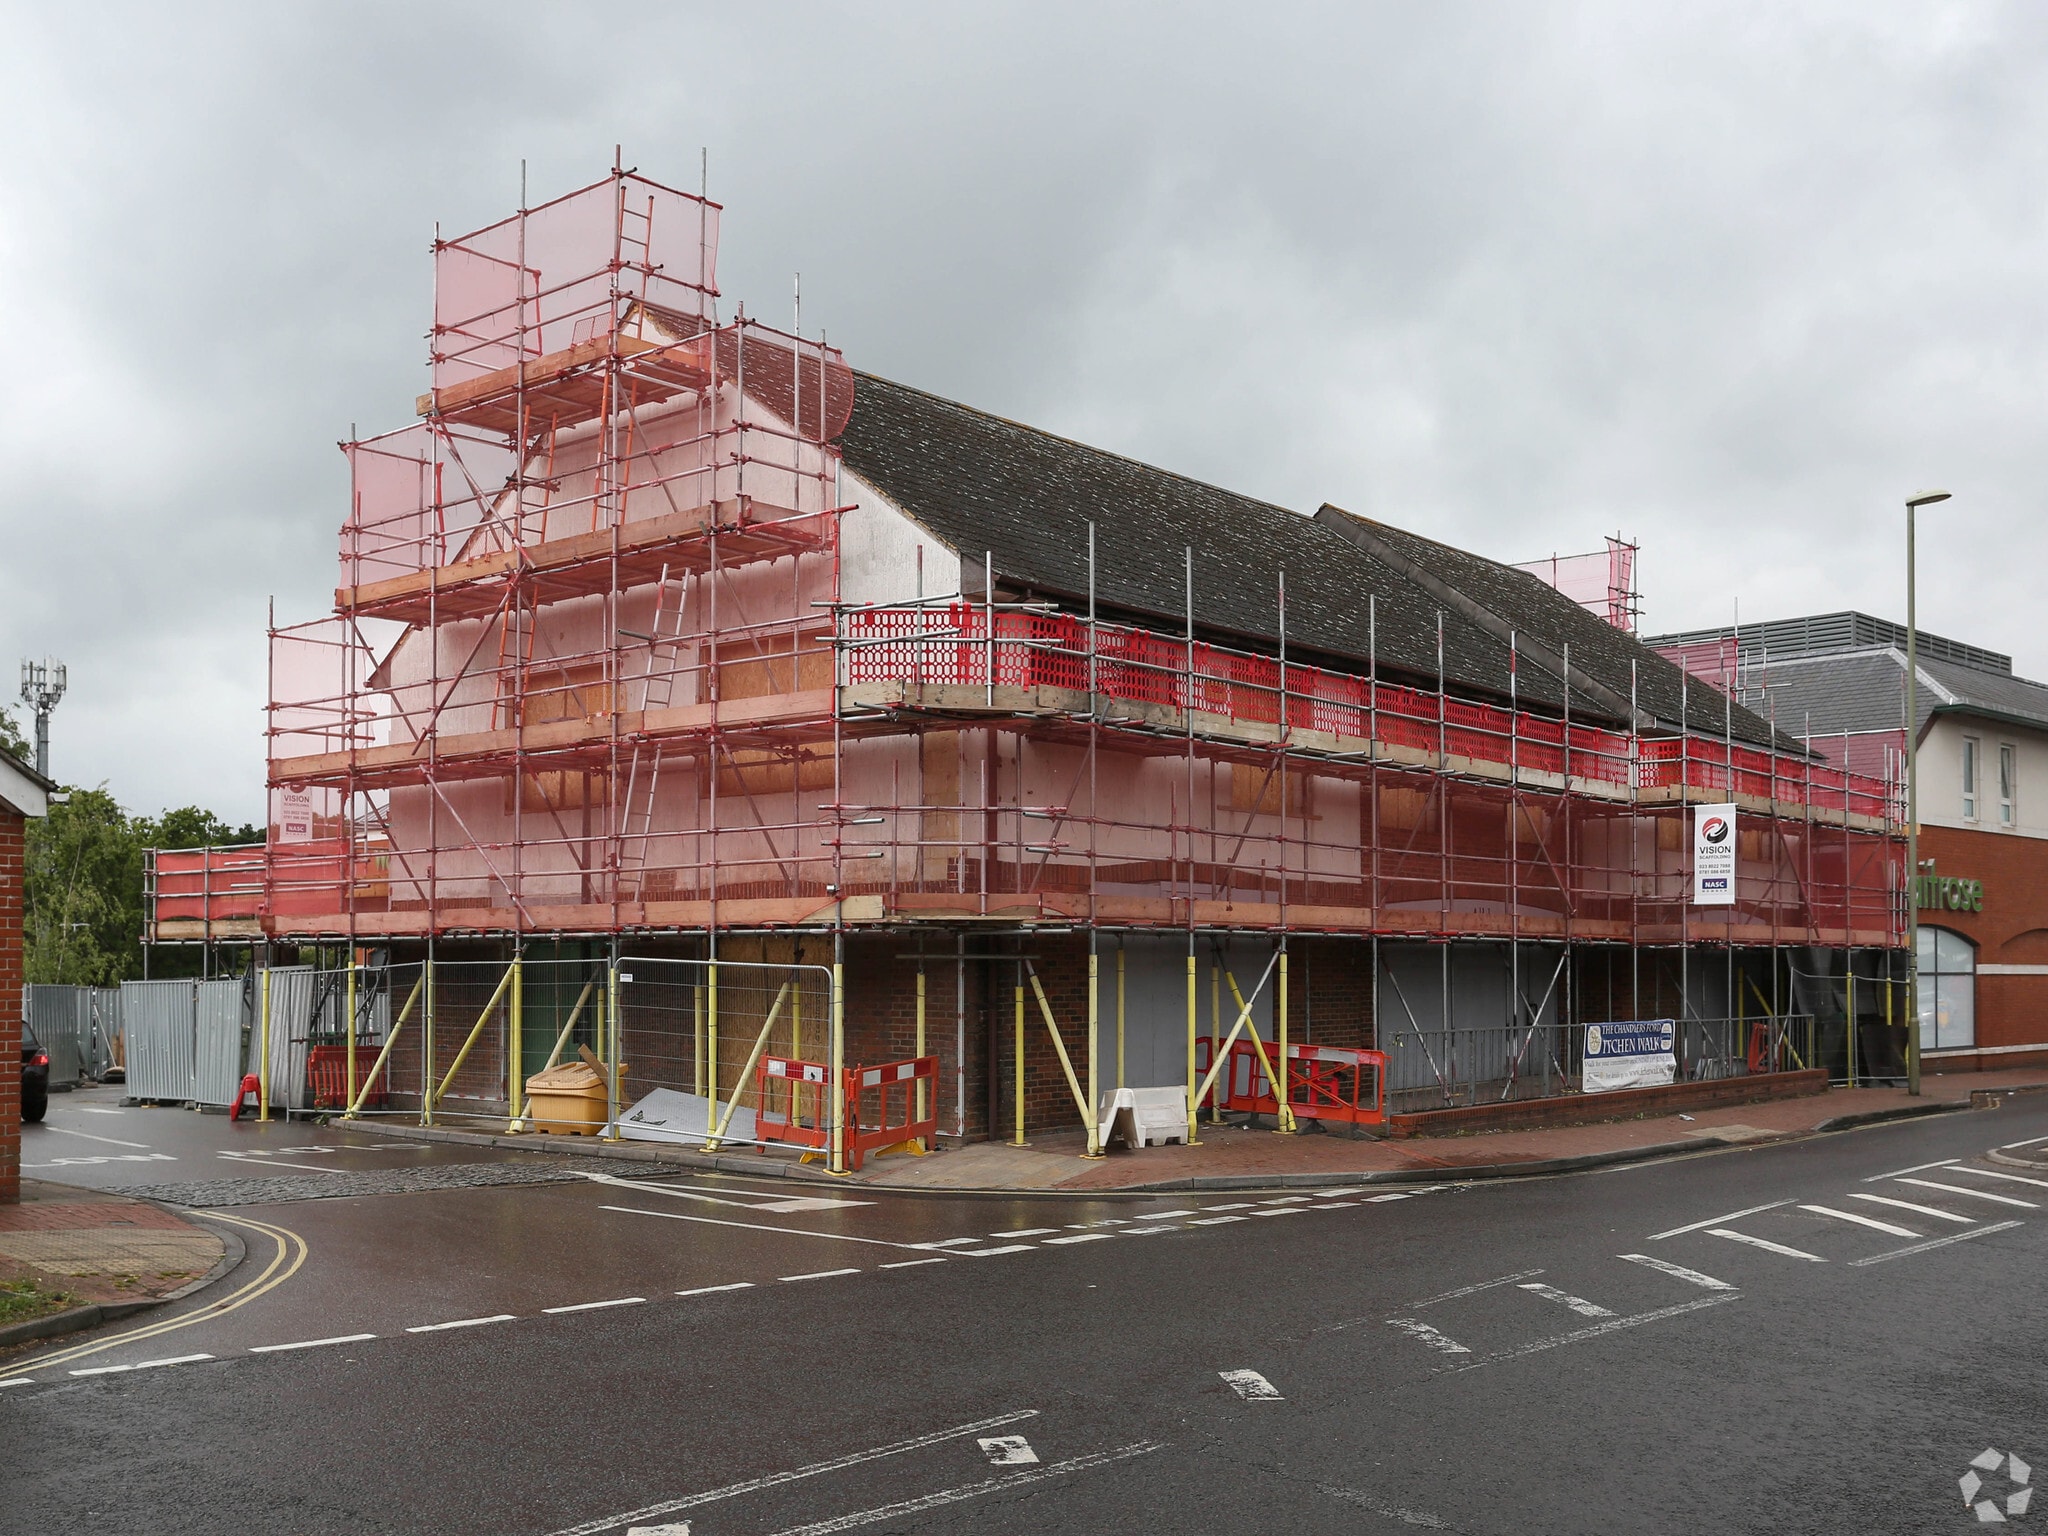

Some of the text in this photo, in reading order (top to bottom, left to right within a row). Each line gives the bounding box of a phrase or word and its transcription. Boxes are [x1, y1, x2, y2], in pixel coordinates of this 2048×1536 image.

[1700, 846, 1731, 854] VISION
[1908, 858, 1983, 912] itrose
[1602, 1025, 1614, 1034] THE
[1646, 1023, 1661, 1032] FORD
[1603, 1037, 1660, 1054] ITCHEN WALK
